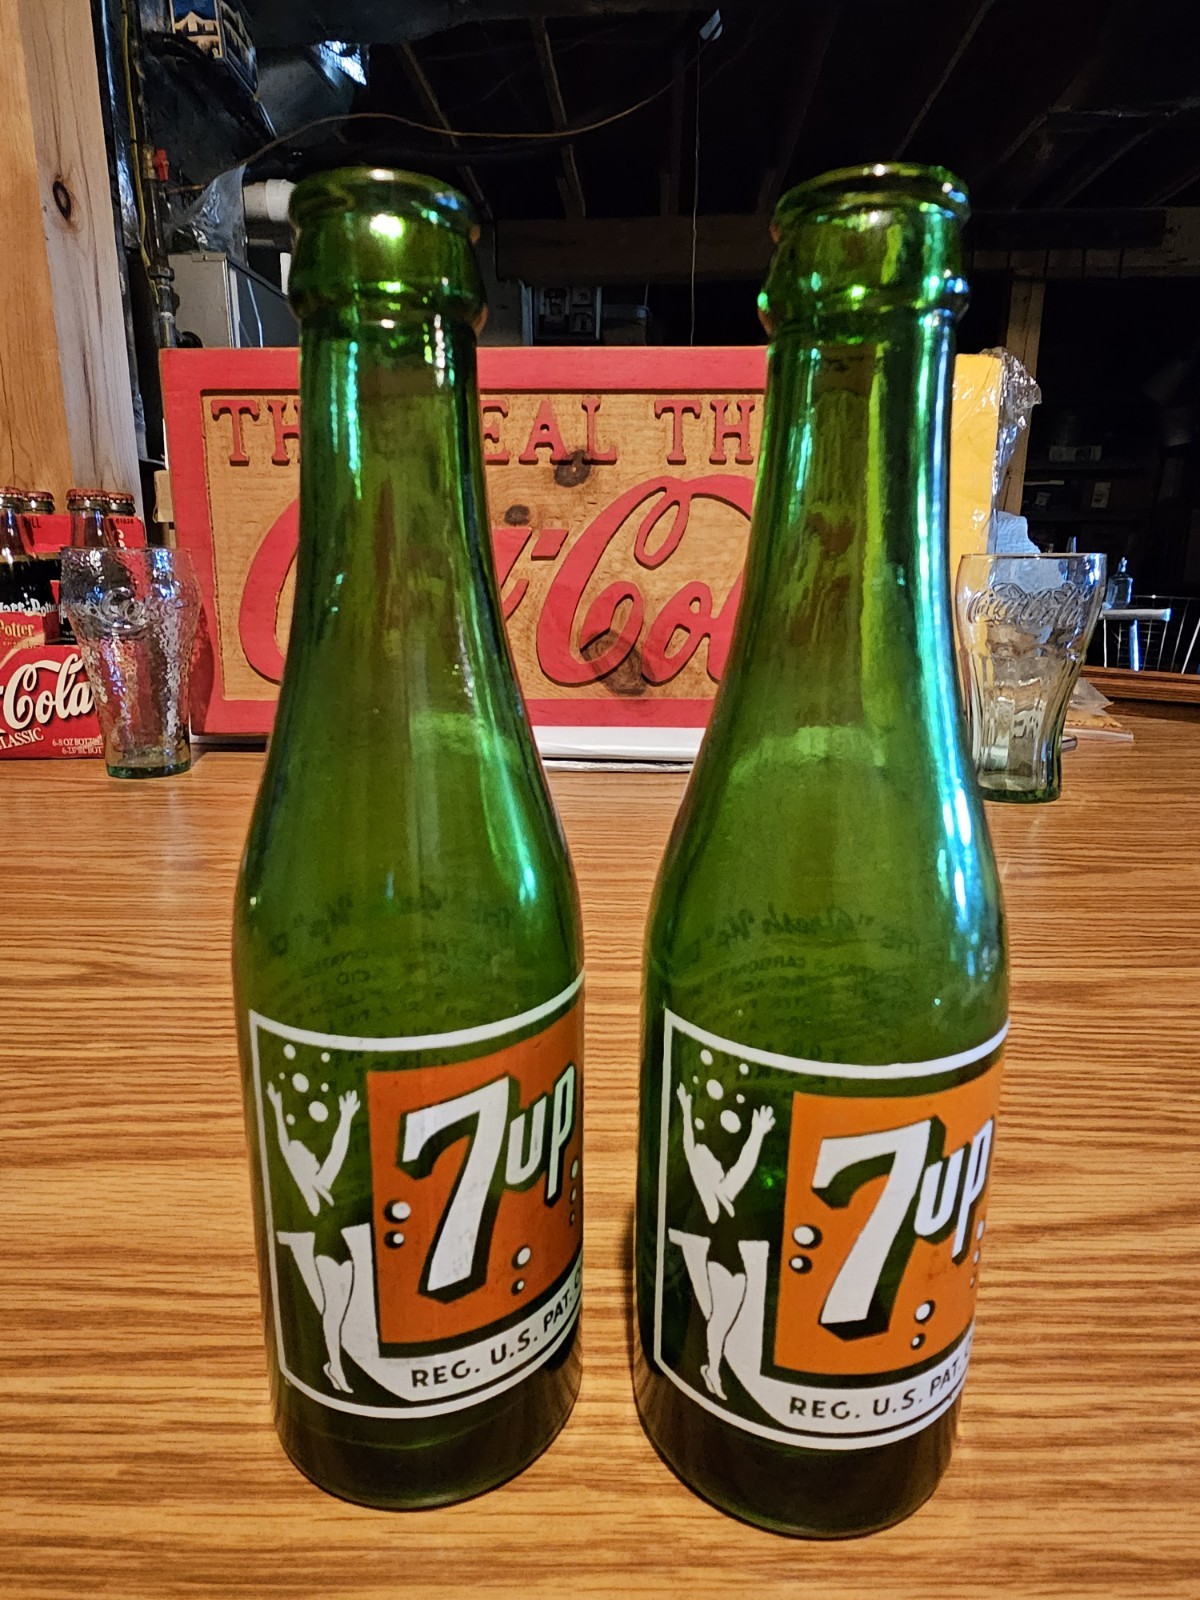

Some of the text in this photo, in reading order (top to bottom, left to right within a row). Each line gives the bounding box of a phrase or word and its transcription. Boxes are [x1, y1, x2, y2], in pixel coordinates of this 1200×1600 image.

[211, 400, 300, 466] TH
[480, 400, 618, 465] EAL
[0, 727, 44, 750] LASSIC
[411, 1291, 573, 1388] REG. U.S. PAT.
[789, 1358, 962, 1419] REG. U.S. PAT.
